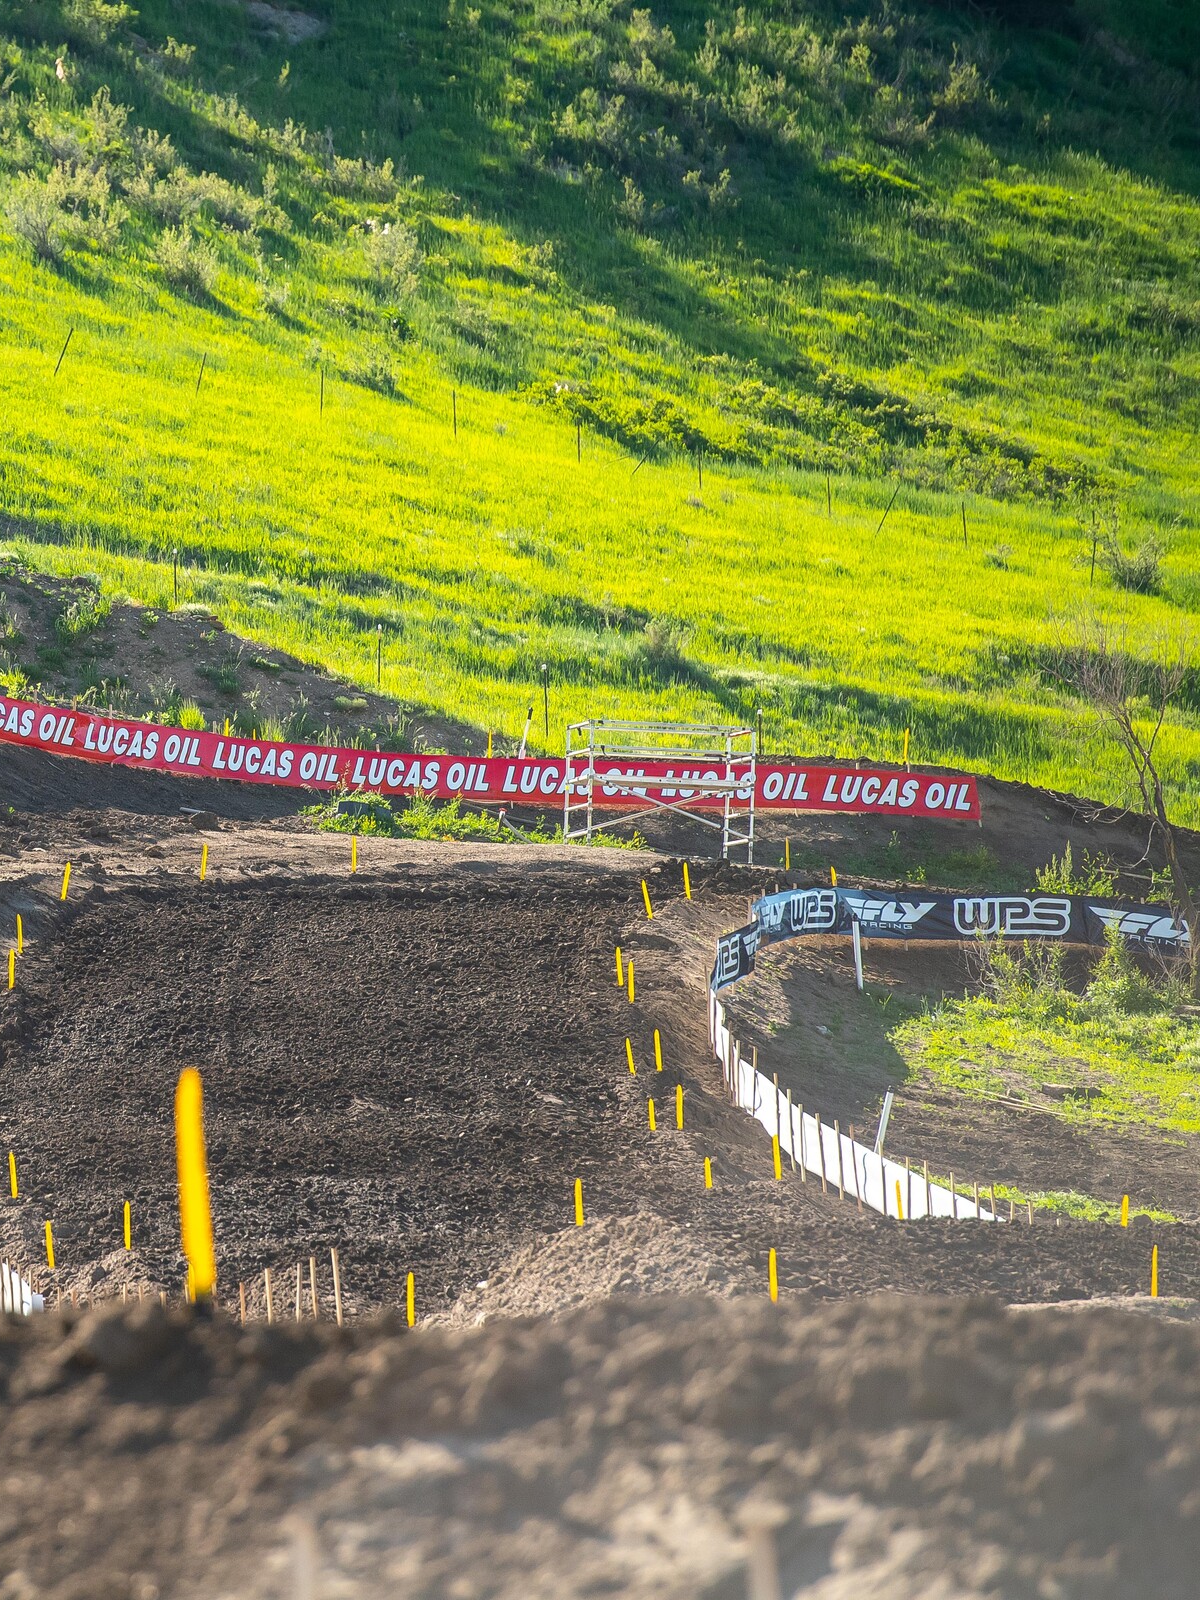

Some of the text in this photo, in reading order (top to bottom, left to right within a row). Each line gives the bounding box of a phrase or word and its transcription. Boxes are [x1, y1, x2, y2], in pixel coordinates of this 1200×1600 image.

[38, 713, 76, 746] OIL
[83, 722, 159, 761] LUCAS
[163, 734, 202, 766] OIL
[212, 741, 295, 778] LUCAS
[299, 752, 340, 782] OIL
[351, 756, 441, 790] LUCAS
[445, 762, 491, 792] OIL
[502, 764, 596, 797] LUCAS
[762, 771, 810, 800] OIL
[822, 774, 920, 808] LUCAS
[924, 782, 972, 811] OIL
[790, 890, 937, 932] WPS FLY
[860, 920, 913, 930] RACING
[953, 897, 1071, 936] WPS
